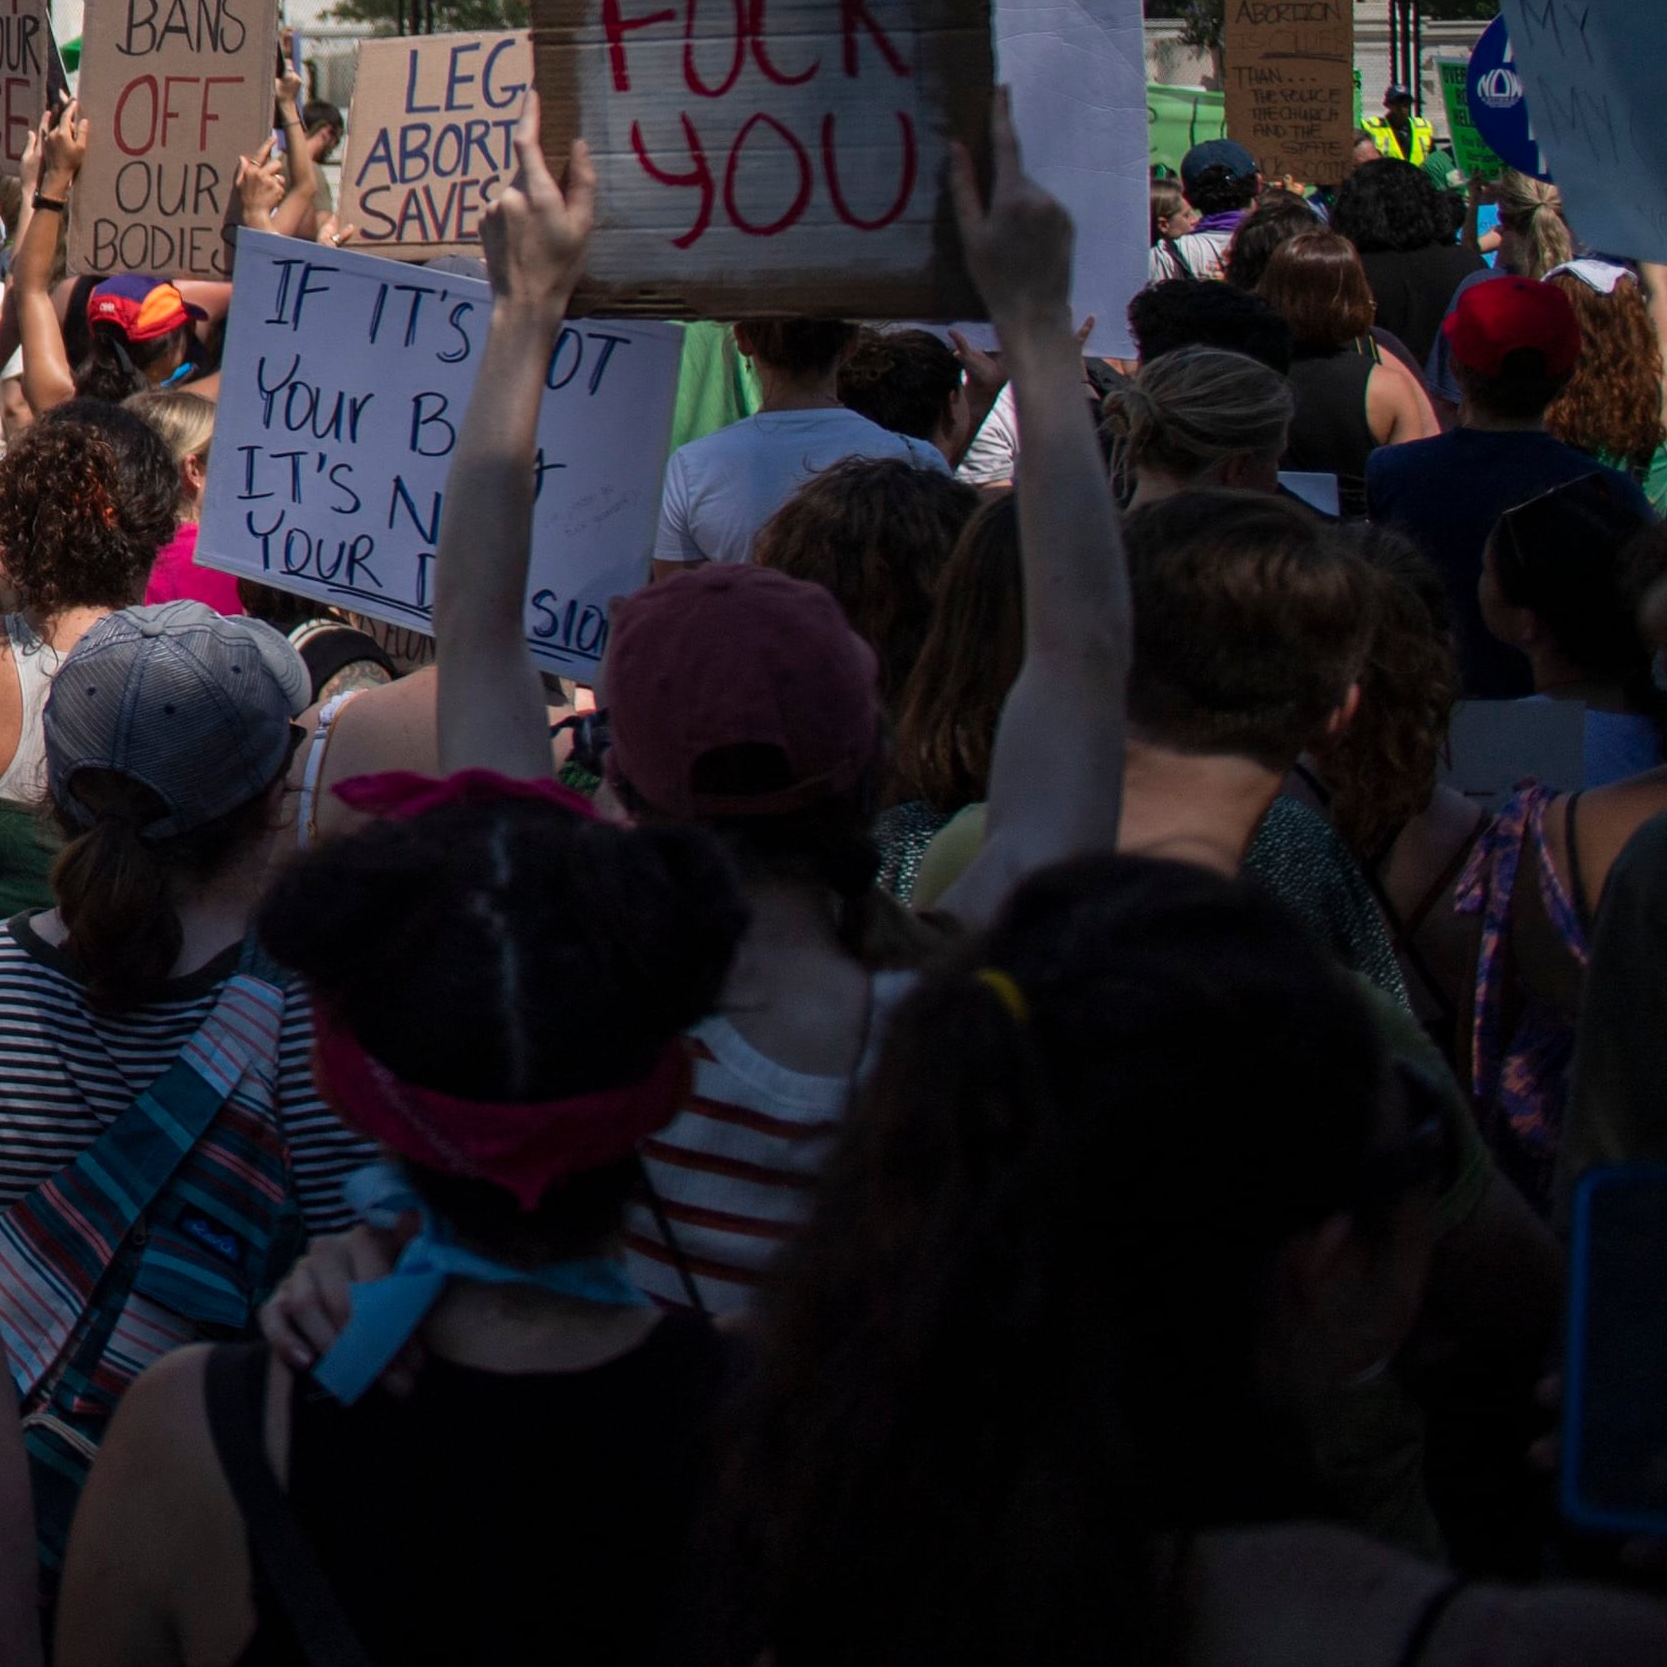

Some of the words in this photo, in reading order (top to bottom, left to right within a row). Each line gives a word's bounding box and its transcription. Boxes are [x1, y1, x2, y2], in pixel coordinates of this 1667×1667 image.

[405, 38, 527, 114] LEG
[113, 74, 245, 156] OFF
[355, 119, 520, 187] ABORT
[115, 160, 220, 217] OUR
[629, 110, 918, 250] YOU
[84, 218, 235, 275] BODIES
[265, 258, 341, 332] IF
[369, 283, 474, 363] IT'S
[547, 327, 632, 397] OT
[237, 445, 362, 515] IT'S
[246, 509, 383, 588] YOUR
